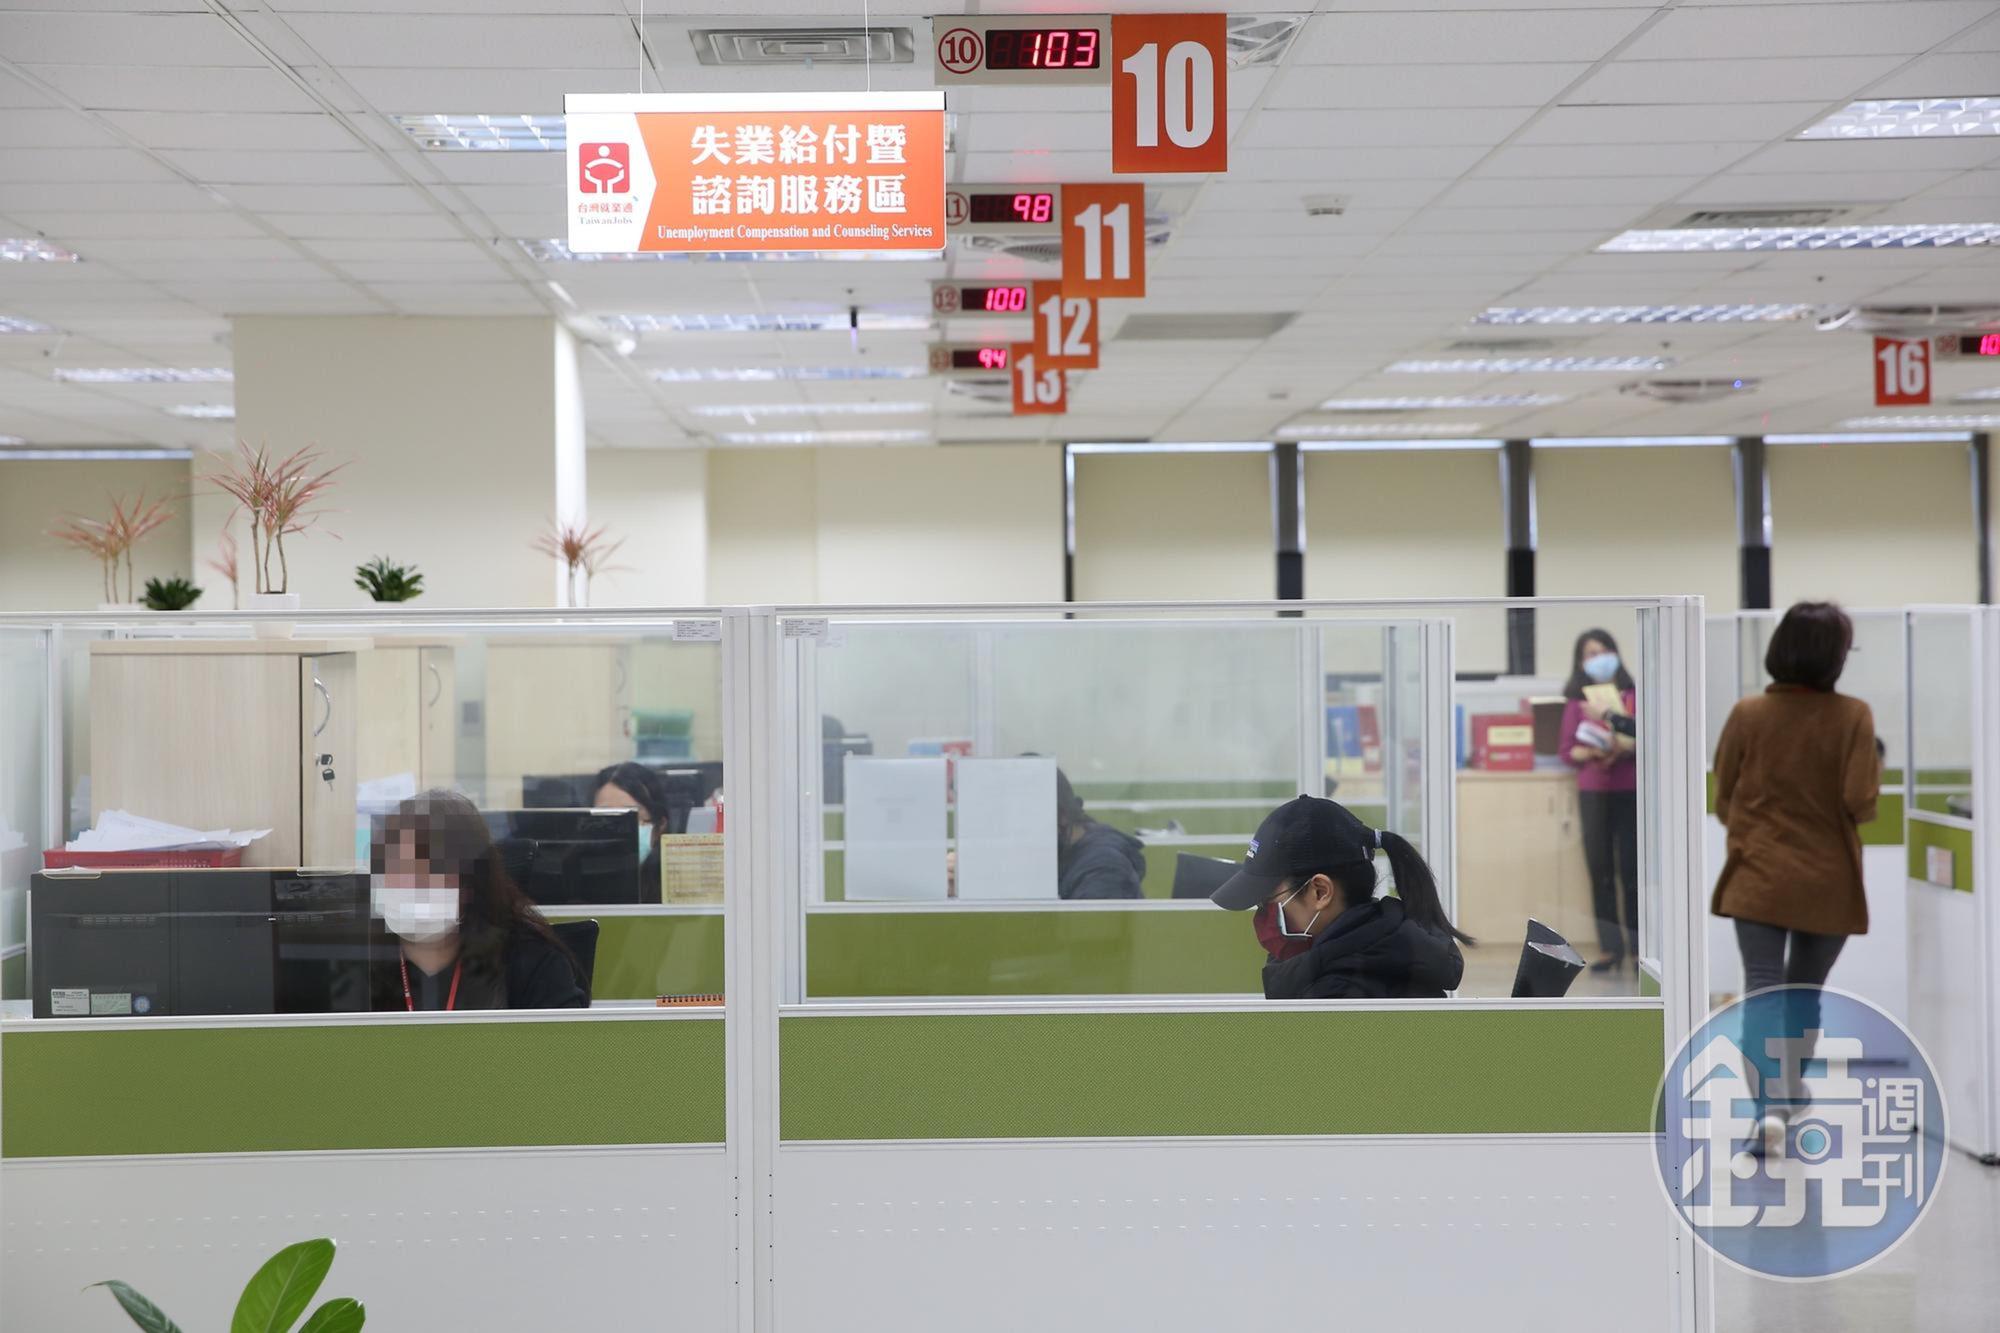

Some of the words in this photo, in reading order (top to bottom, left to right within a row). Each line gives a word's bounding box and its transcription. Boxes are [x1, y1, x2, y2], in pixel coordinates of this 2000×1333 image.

[944, 36, 977, 64] 10
[1031, 31, 1097, 67] 103
[1122, 40, 1215, 148] 10
[690, 124, 907, 165] 失業給付暨
[690, 174, 907, 215] 諮詢服務區
[1013, 194, 1052, 222] 98
[657, 225, 735, 241] Unemployment
[737, 225, 809, 240] Compensation
[812, 225, 831, 238] and
[833, 224, 889, 240] Counseling
[891, 223, 932, 238] Services
[1074, 203, 1130, 280] 11
[986, 287, 1026, 311] 100
[1039, 295, 1093, 357] 12
[978, 348, 1007, 368] 94
[1878, 343, 1925, 395] 16
[1016, 354, 1061, 404] 13
